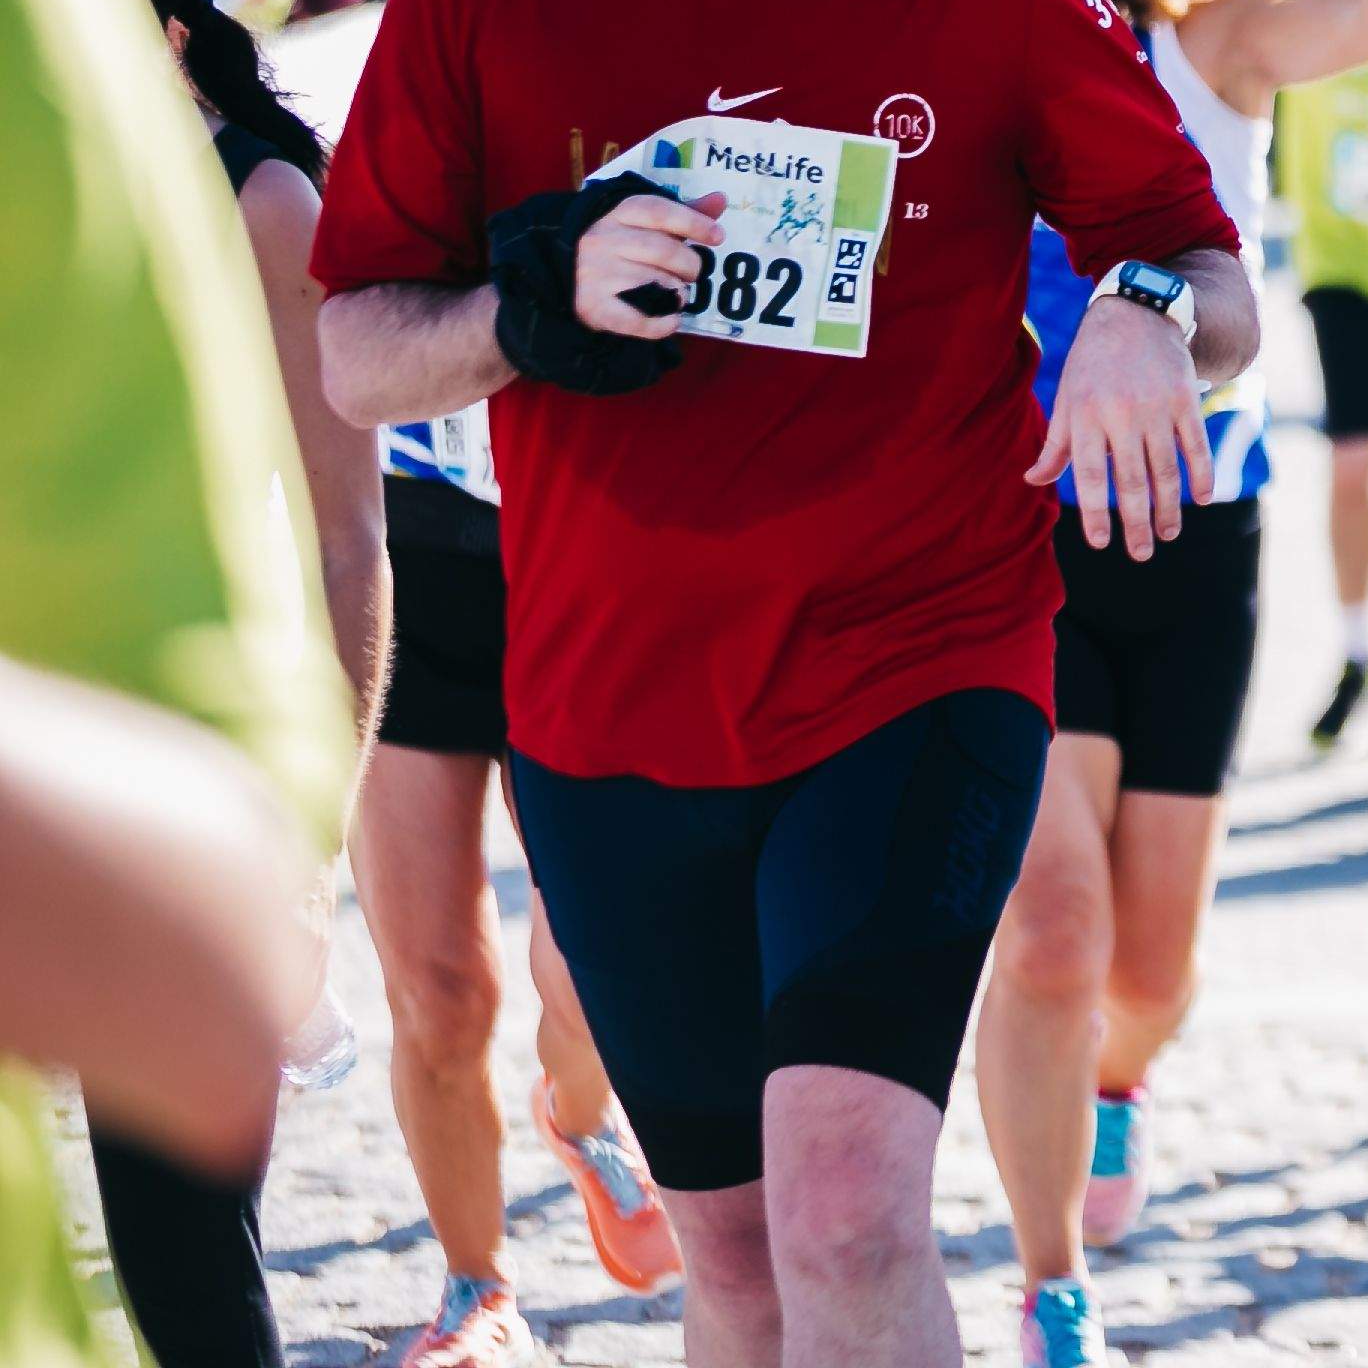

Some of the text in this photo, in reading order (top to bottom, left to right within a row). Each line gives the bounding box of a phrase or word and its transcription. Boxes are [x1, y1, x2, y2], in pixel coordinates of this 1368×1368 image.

[885, 113, 925, 140] 10K
[704, 142, 824, 184] MetLife
[904, 202, 929, 220] 13
